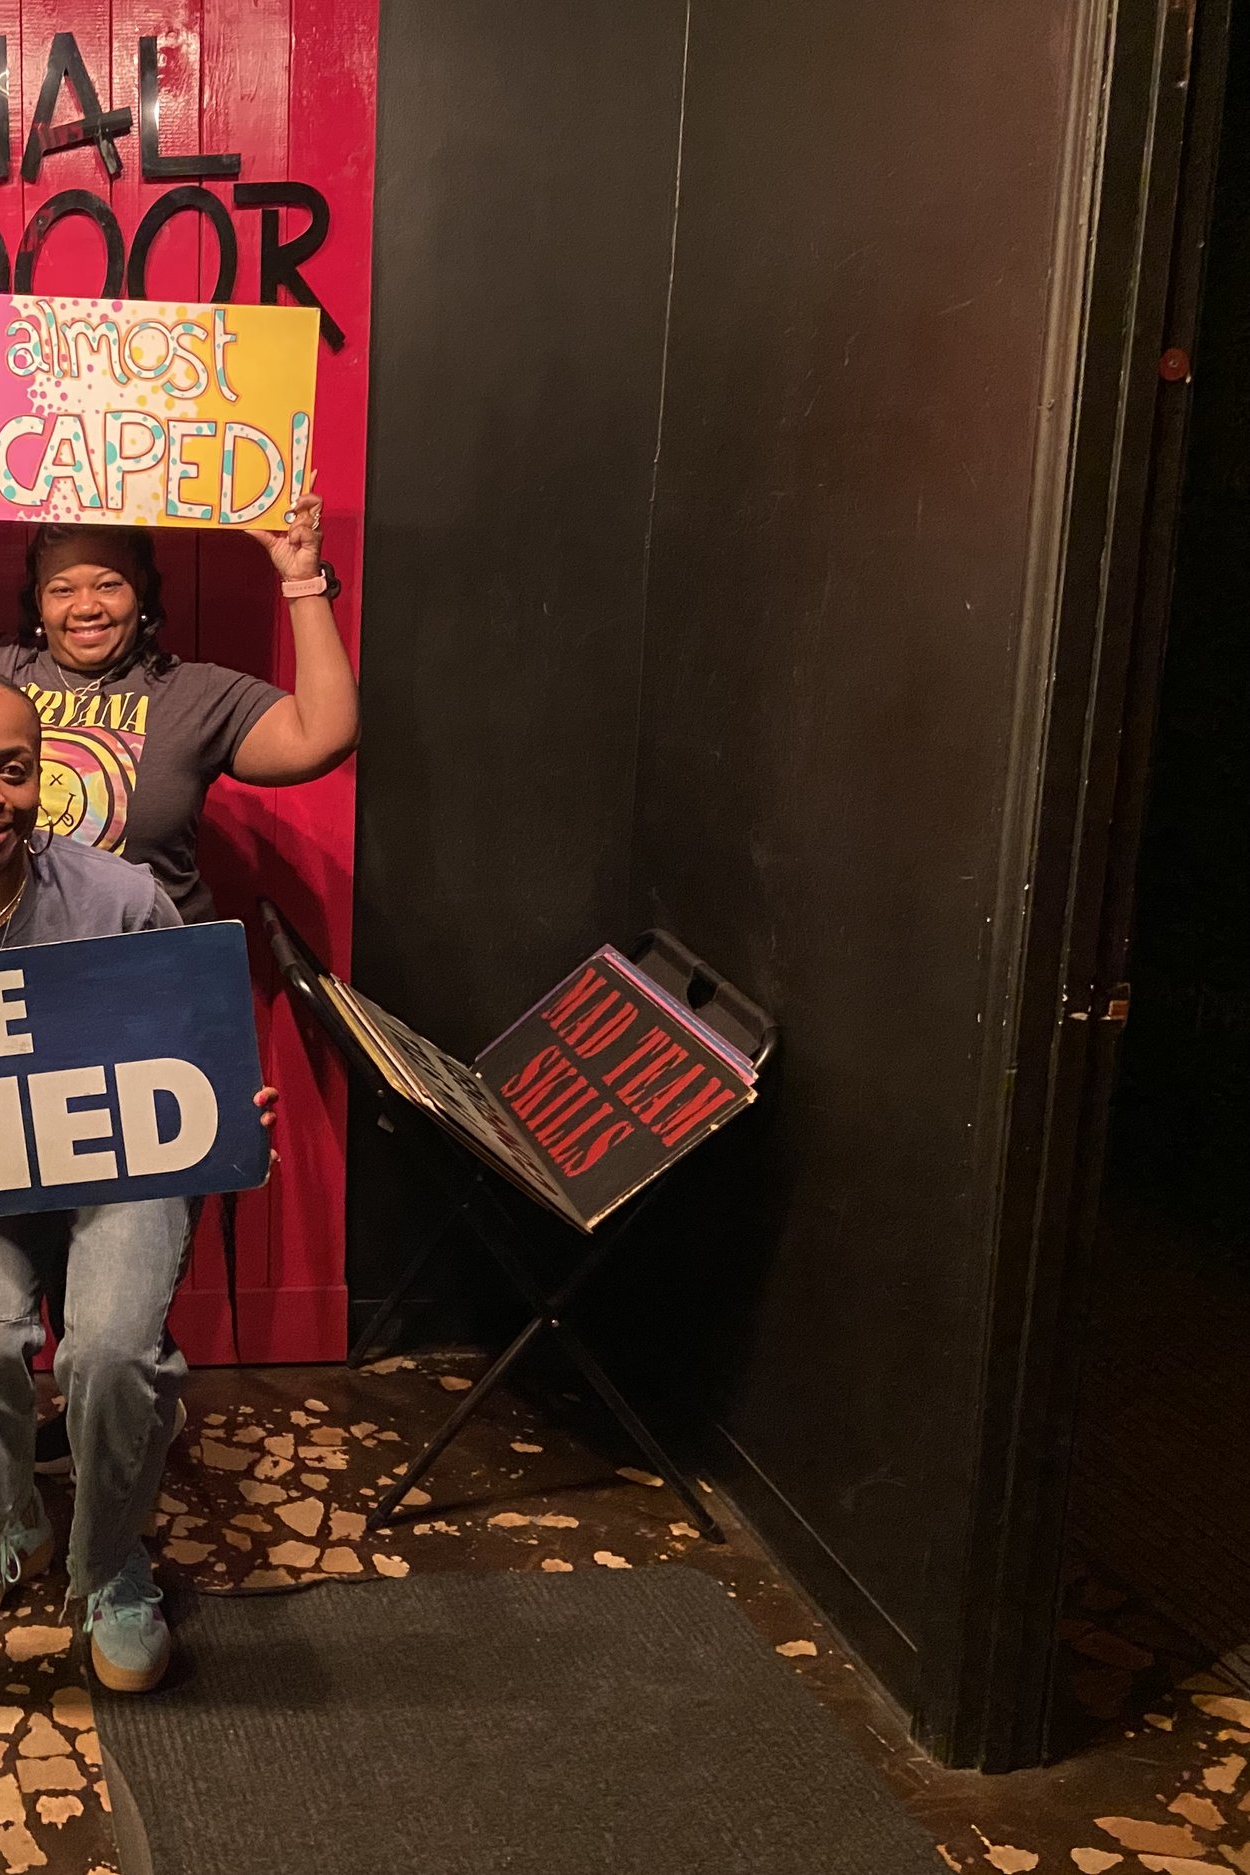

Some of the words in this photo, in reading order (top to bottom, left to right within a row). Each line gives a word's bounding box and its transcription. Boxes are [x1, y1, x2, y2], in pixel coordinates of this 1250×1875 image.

[5, 299, 239, 403] almost
[20, 682, 149, 735] RVANA
[500, 1044, 635, 1178] SKILLS
[541, 967, 639, 1059] MAD
[602, 1025, 736, 1147] TEAM
